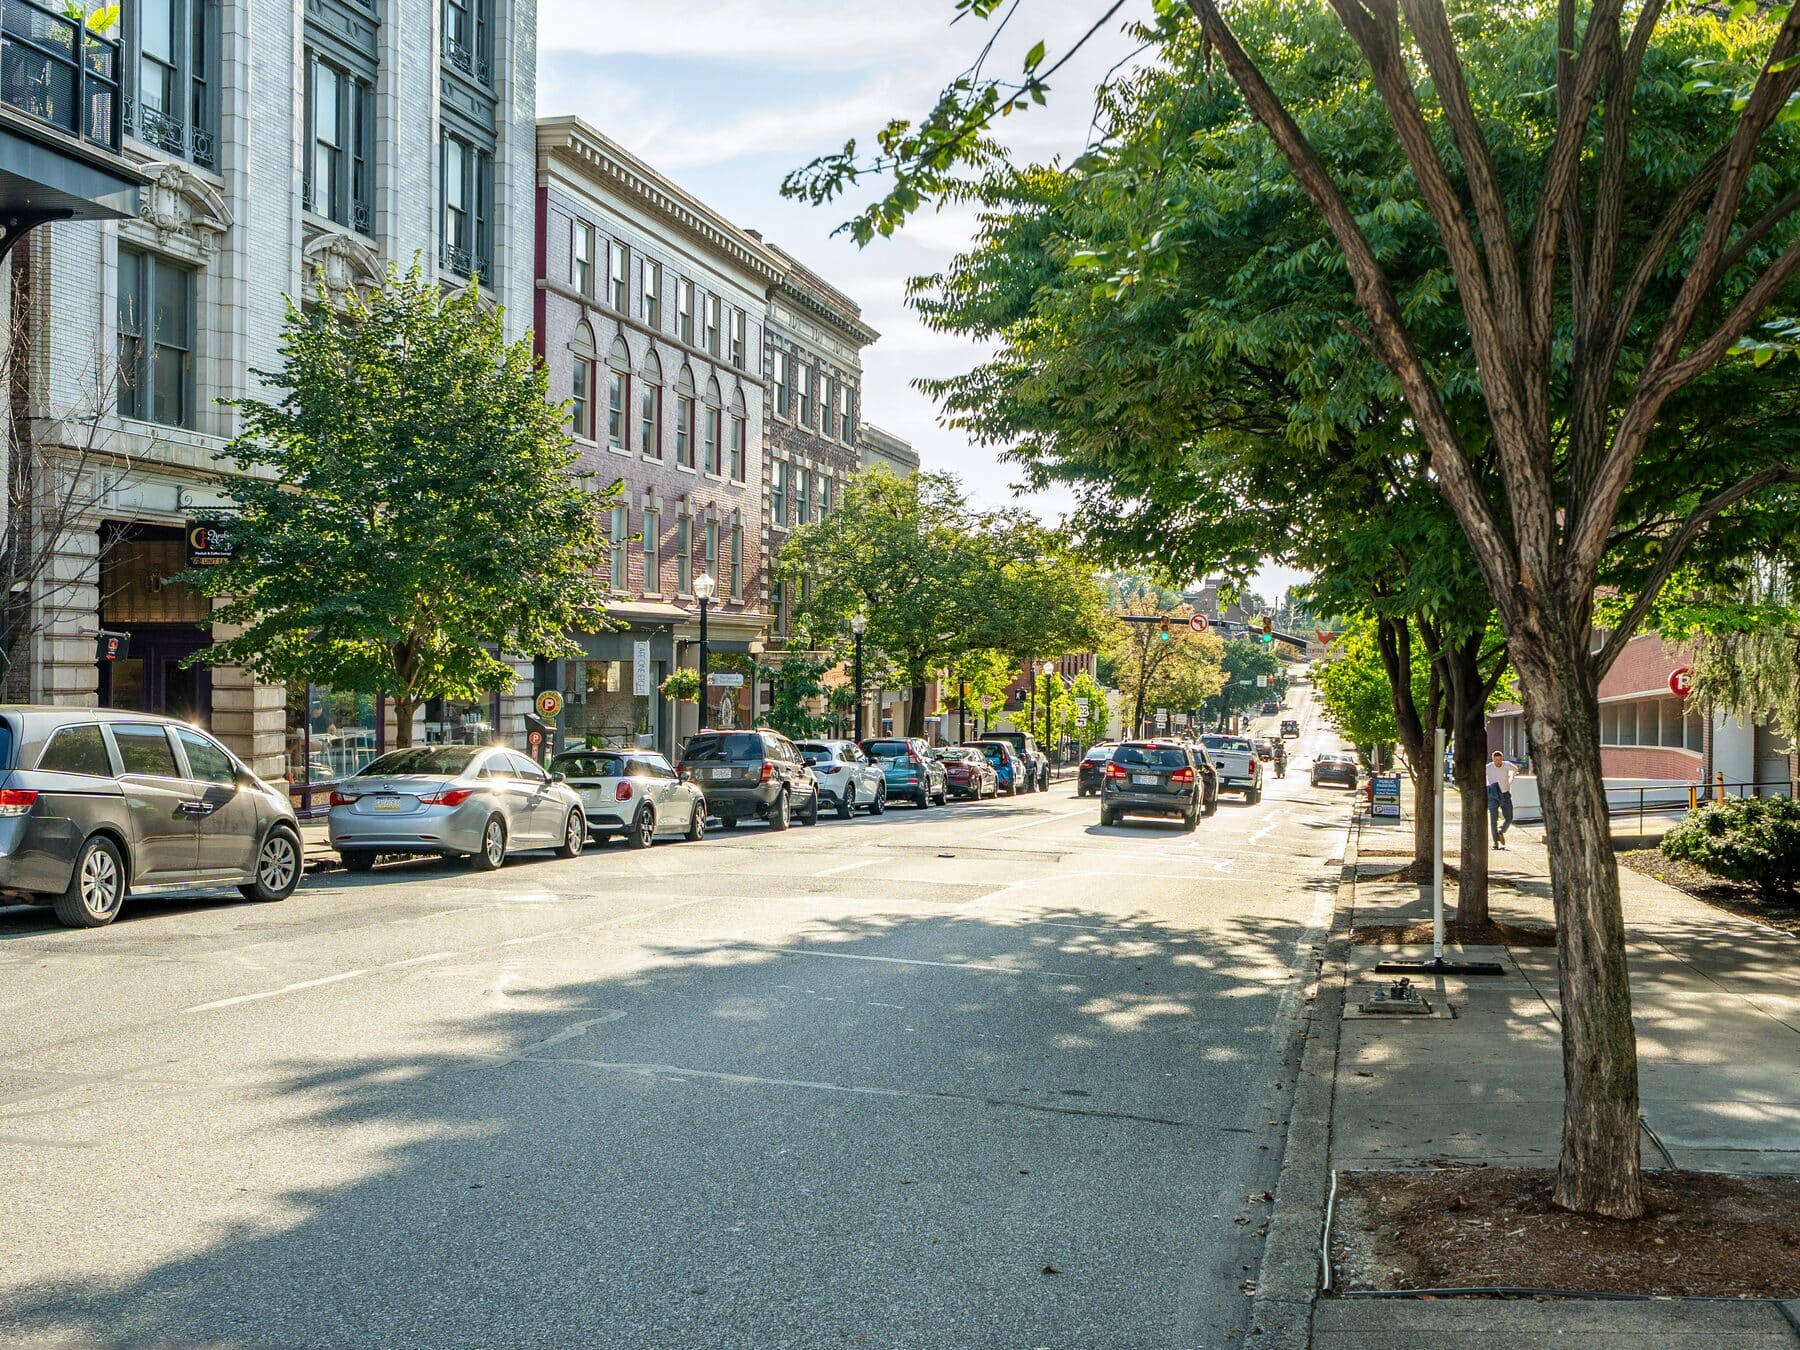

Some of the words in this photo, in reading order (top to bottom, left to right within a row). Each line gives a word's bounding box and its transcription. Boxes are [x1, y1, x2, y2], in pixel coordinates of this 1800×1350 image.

[637, 643, 646, 657] CAFE
[637, 658, 646, 674] ONE
[1677, 675, 1691, 690] P
[544, 699, 555, 710] P
[533, 735, 540, 743] P
